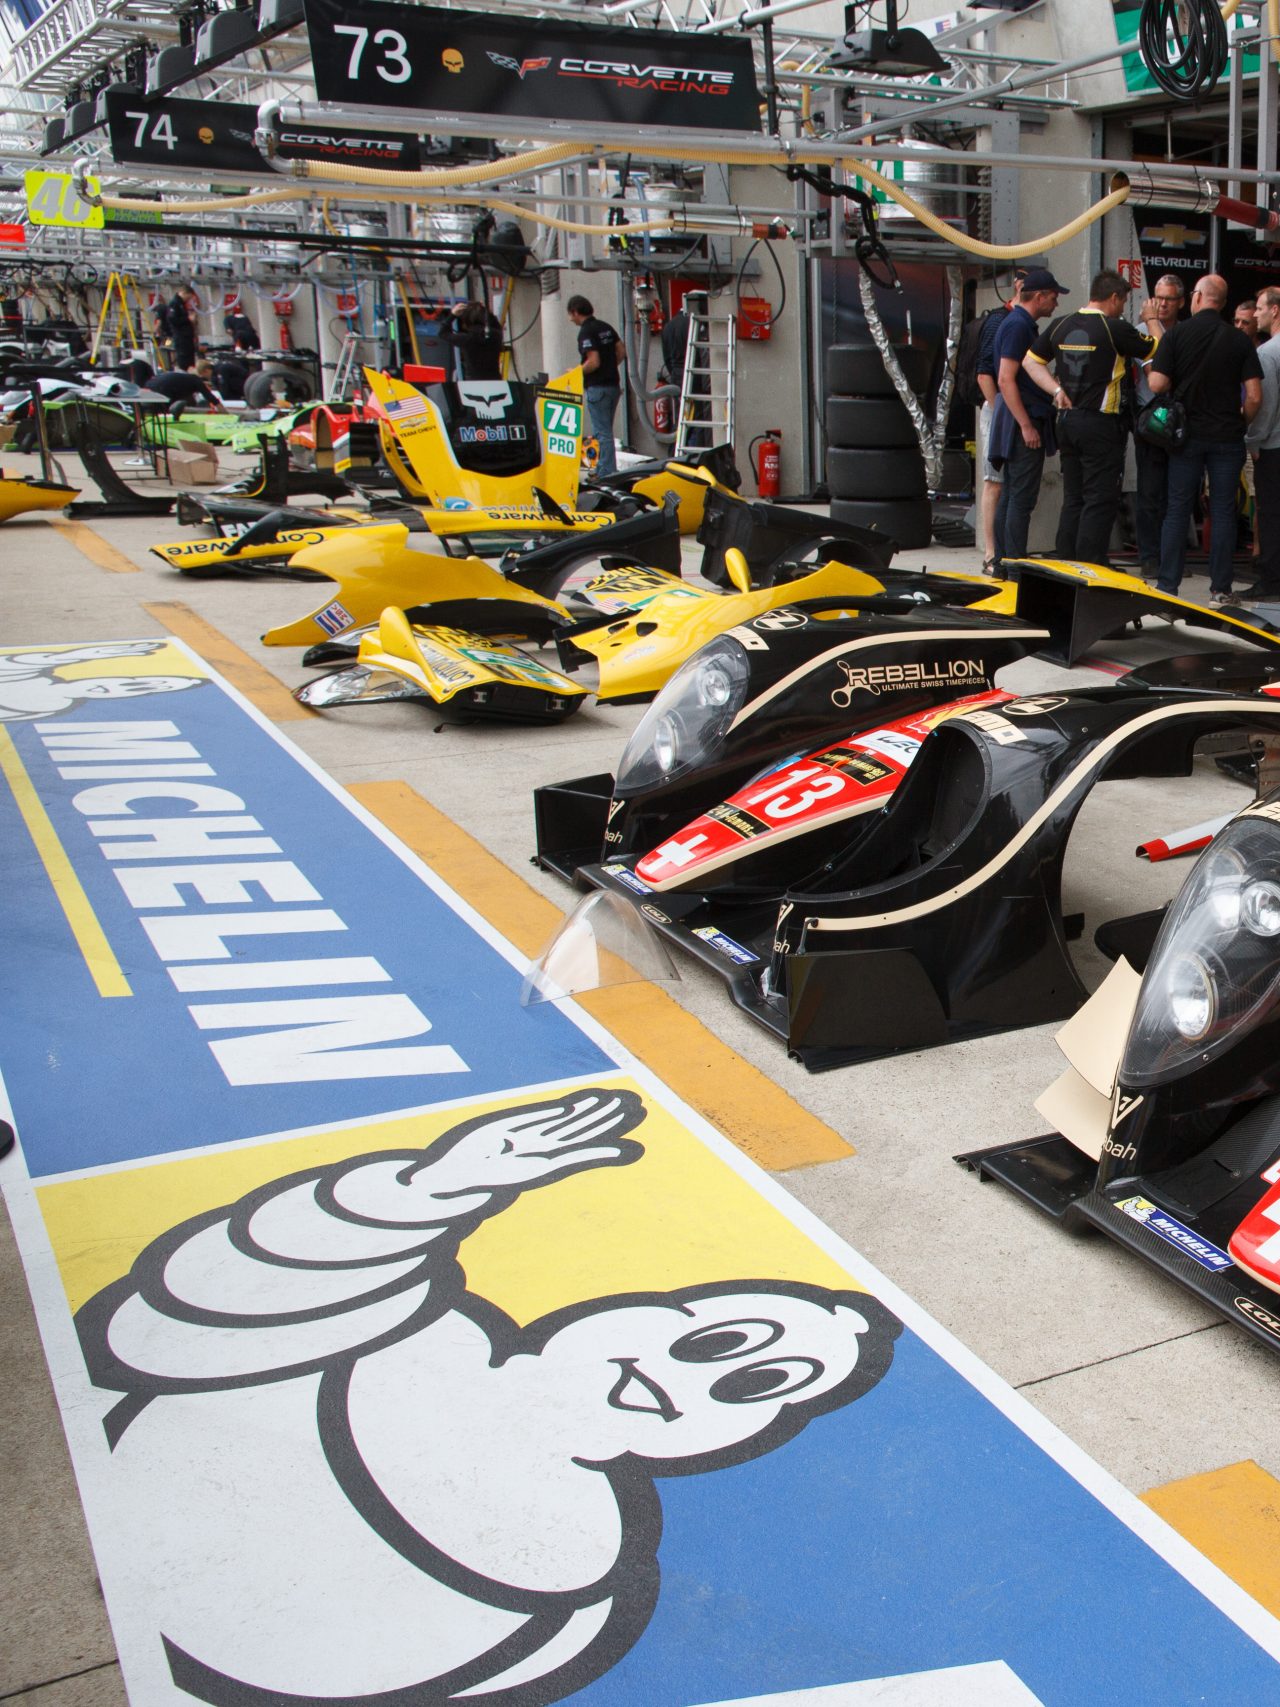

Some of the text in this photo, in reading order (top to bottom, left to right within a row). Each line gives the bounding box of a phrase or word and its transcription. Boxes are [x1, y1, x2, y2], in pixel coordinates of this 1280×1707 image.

[333, 24, 412, 83] 73
[559, 59, 735, 84] CORVETTE
[617, 79, 730, 96] RACING
[125, 111, 178, 150] 74
[280, 132, 403, 151] CORVETTE
[319, 145, 400, 158] RACING
[1141, 255, 1209, 269] CHEVROLET
[547, 403, 577, 434] 74
[460, 426, 508, 442] Mobil
[549, 437, 575, 456] PRO
[848, 659, 984, 687] REBELLION
[881, 677, 986, 692] ULTIMATE SWISS TIMEPIECES
[746, 766, 846, 819] 13
[34, 720, 471, 1087] MICHELIN
[1150, 1218, 1232, 1267] MICHELIN
